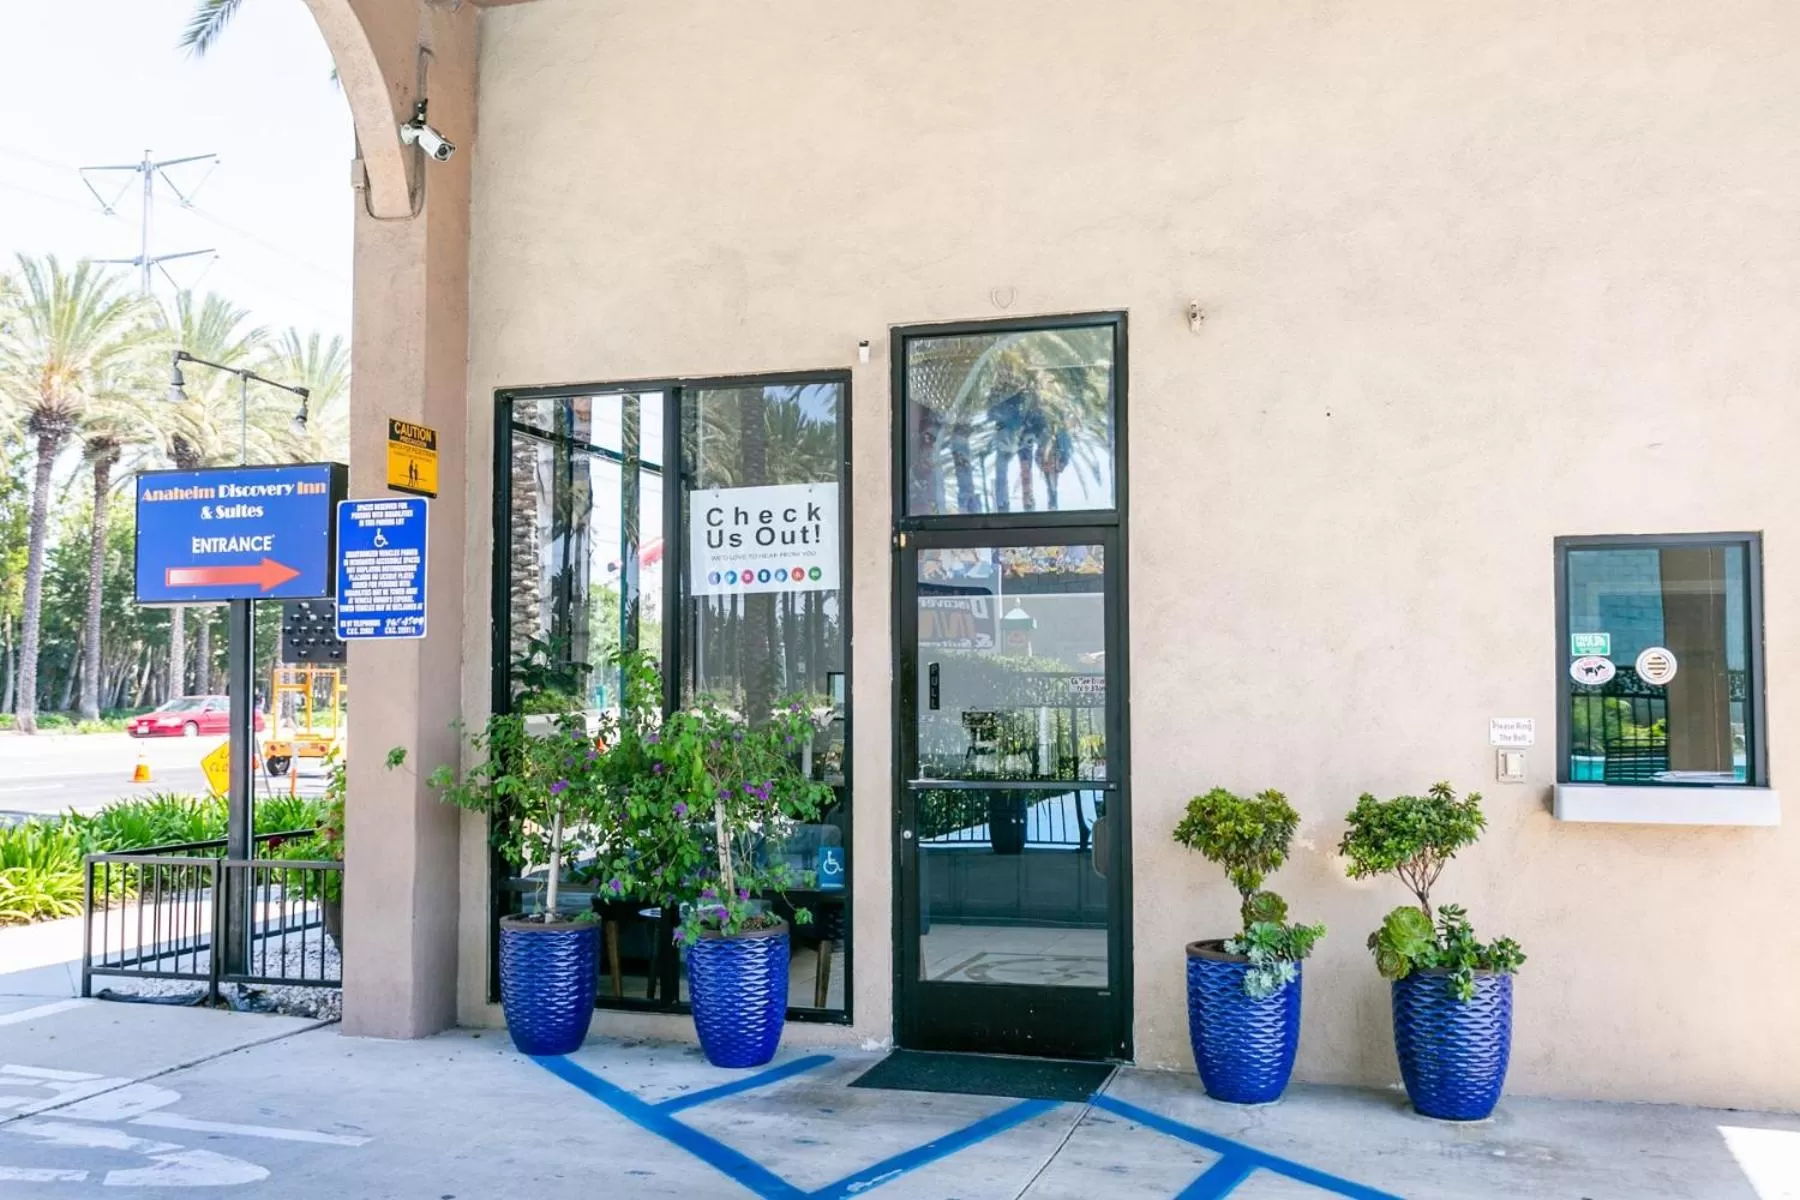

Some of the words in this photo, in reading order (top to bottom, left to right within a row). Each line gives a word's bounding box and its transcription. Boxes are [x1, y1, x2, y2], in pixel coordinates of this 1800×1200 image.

[394, 421, 432, 442] CAUTION
[142, 486, 215, 501] Anaheim
[218, 483, 295, 498] Discovery
[296, 481, 327, 495] Inn
[200, 505, 213, 520] &
[215, 503, 264, 519] Suites
[706, 502, 822, 527] Check
[192, 536, 272, 554] ENTRANCE
[706, 529, 743, 549] Us
[755, 524, 821, 546] Out!
